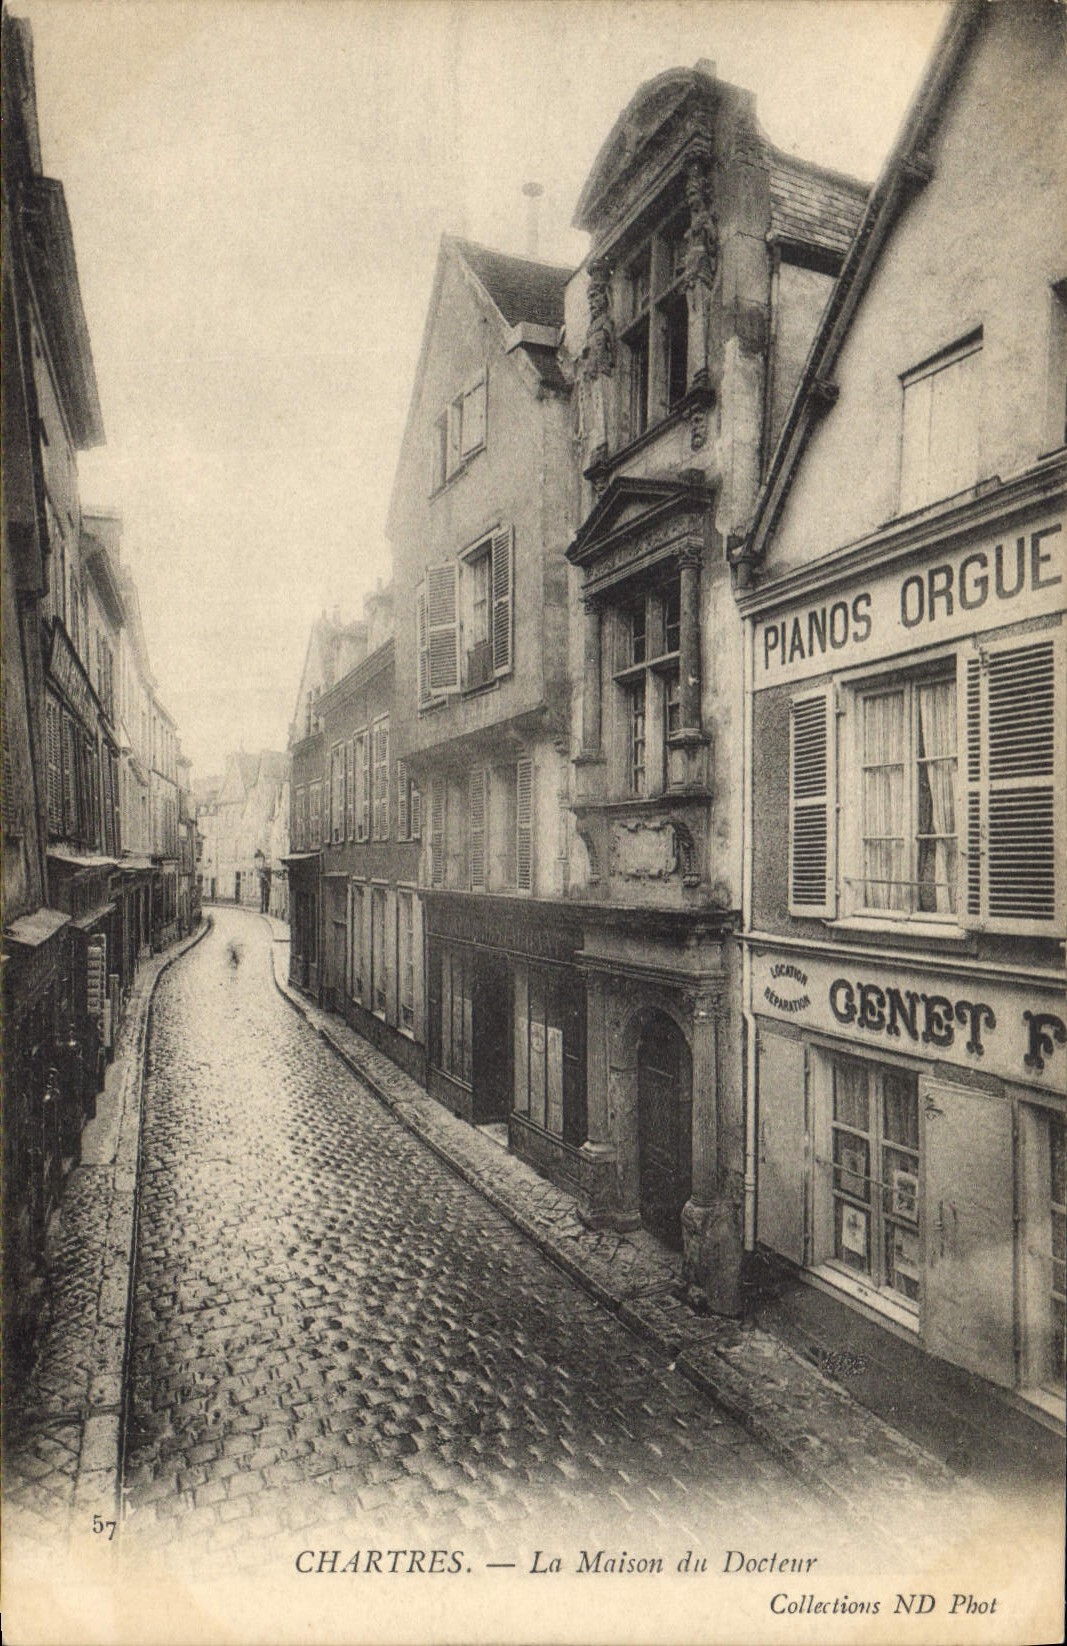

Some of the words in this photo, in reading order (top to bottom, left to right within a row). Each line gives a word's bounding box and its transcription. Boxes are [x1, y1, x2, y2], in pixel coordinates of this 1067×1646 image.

[763, 592, 873, 671] PIANOS
[899, 524, 1063, 629] ORGUE
[770, 963, 809, 987] LOCATION
[829, 978, 997, 1057] GENET
